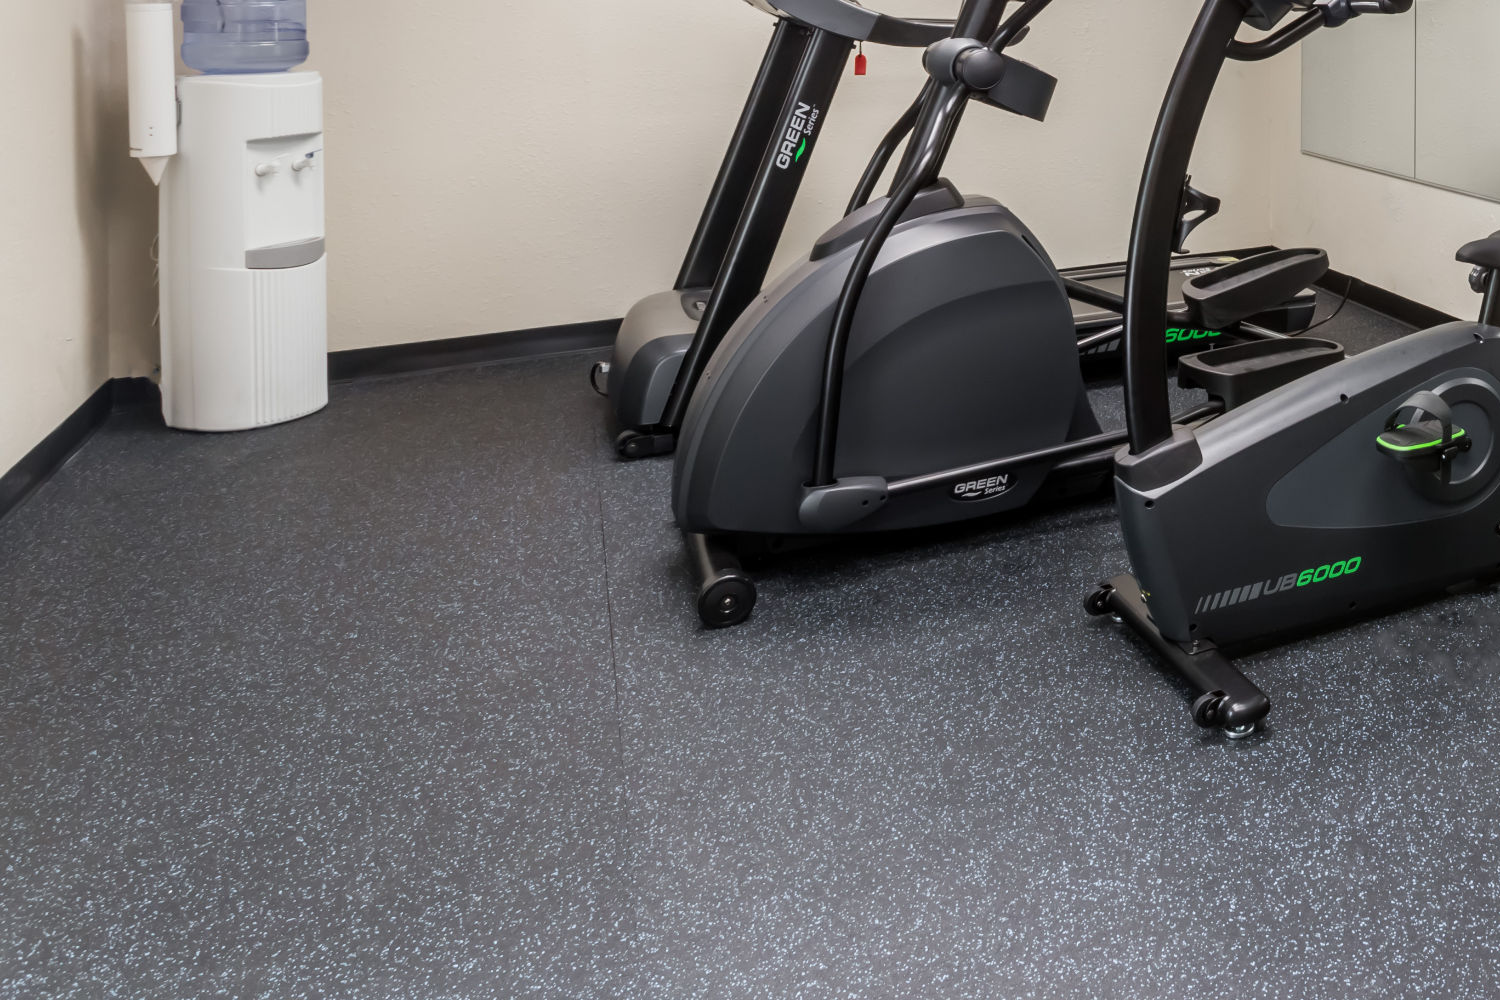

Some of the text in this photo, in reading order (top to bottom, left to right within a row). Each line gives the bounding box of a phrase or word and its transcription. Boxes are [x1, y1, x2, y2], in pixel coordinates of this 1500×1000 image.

[775, 101, 811, 170] GREEN
[803, 107, 819, 136] Series
[954, 474, 1009, 494] GREEN
[983, 485, 1006, 495] Series
[1263, 556, 1362, 596] UB6000
